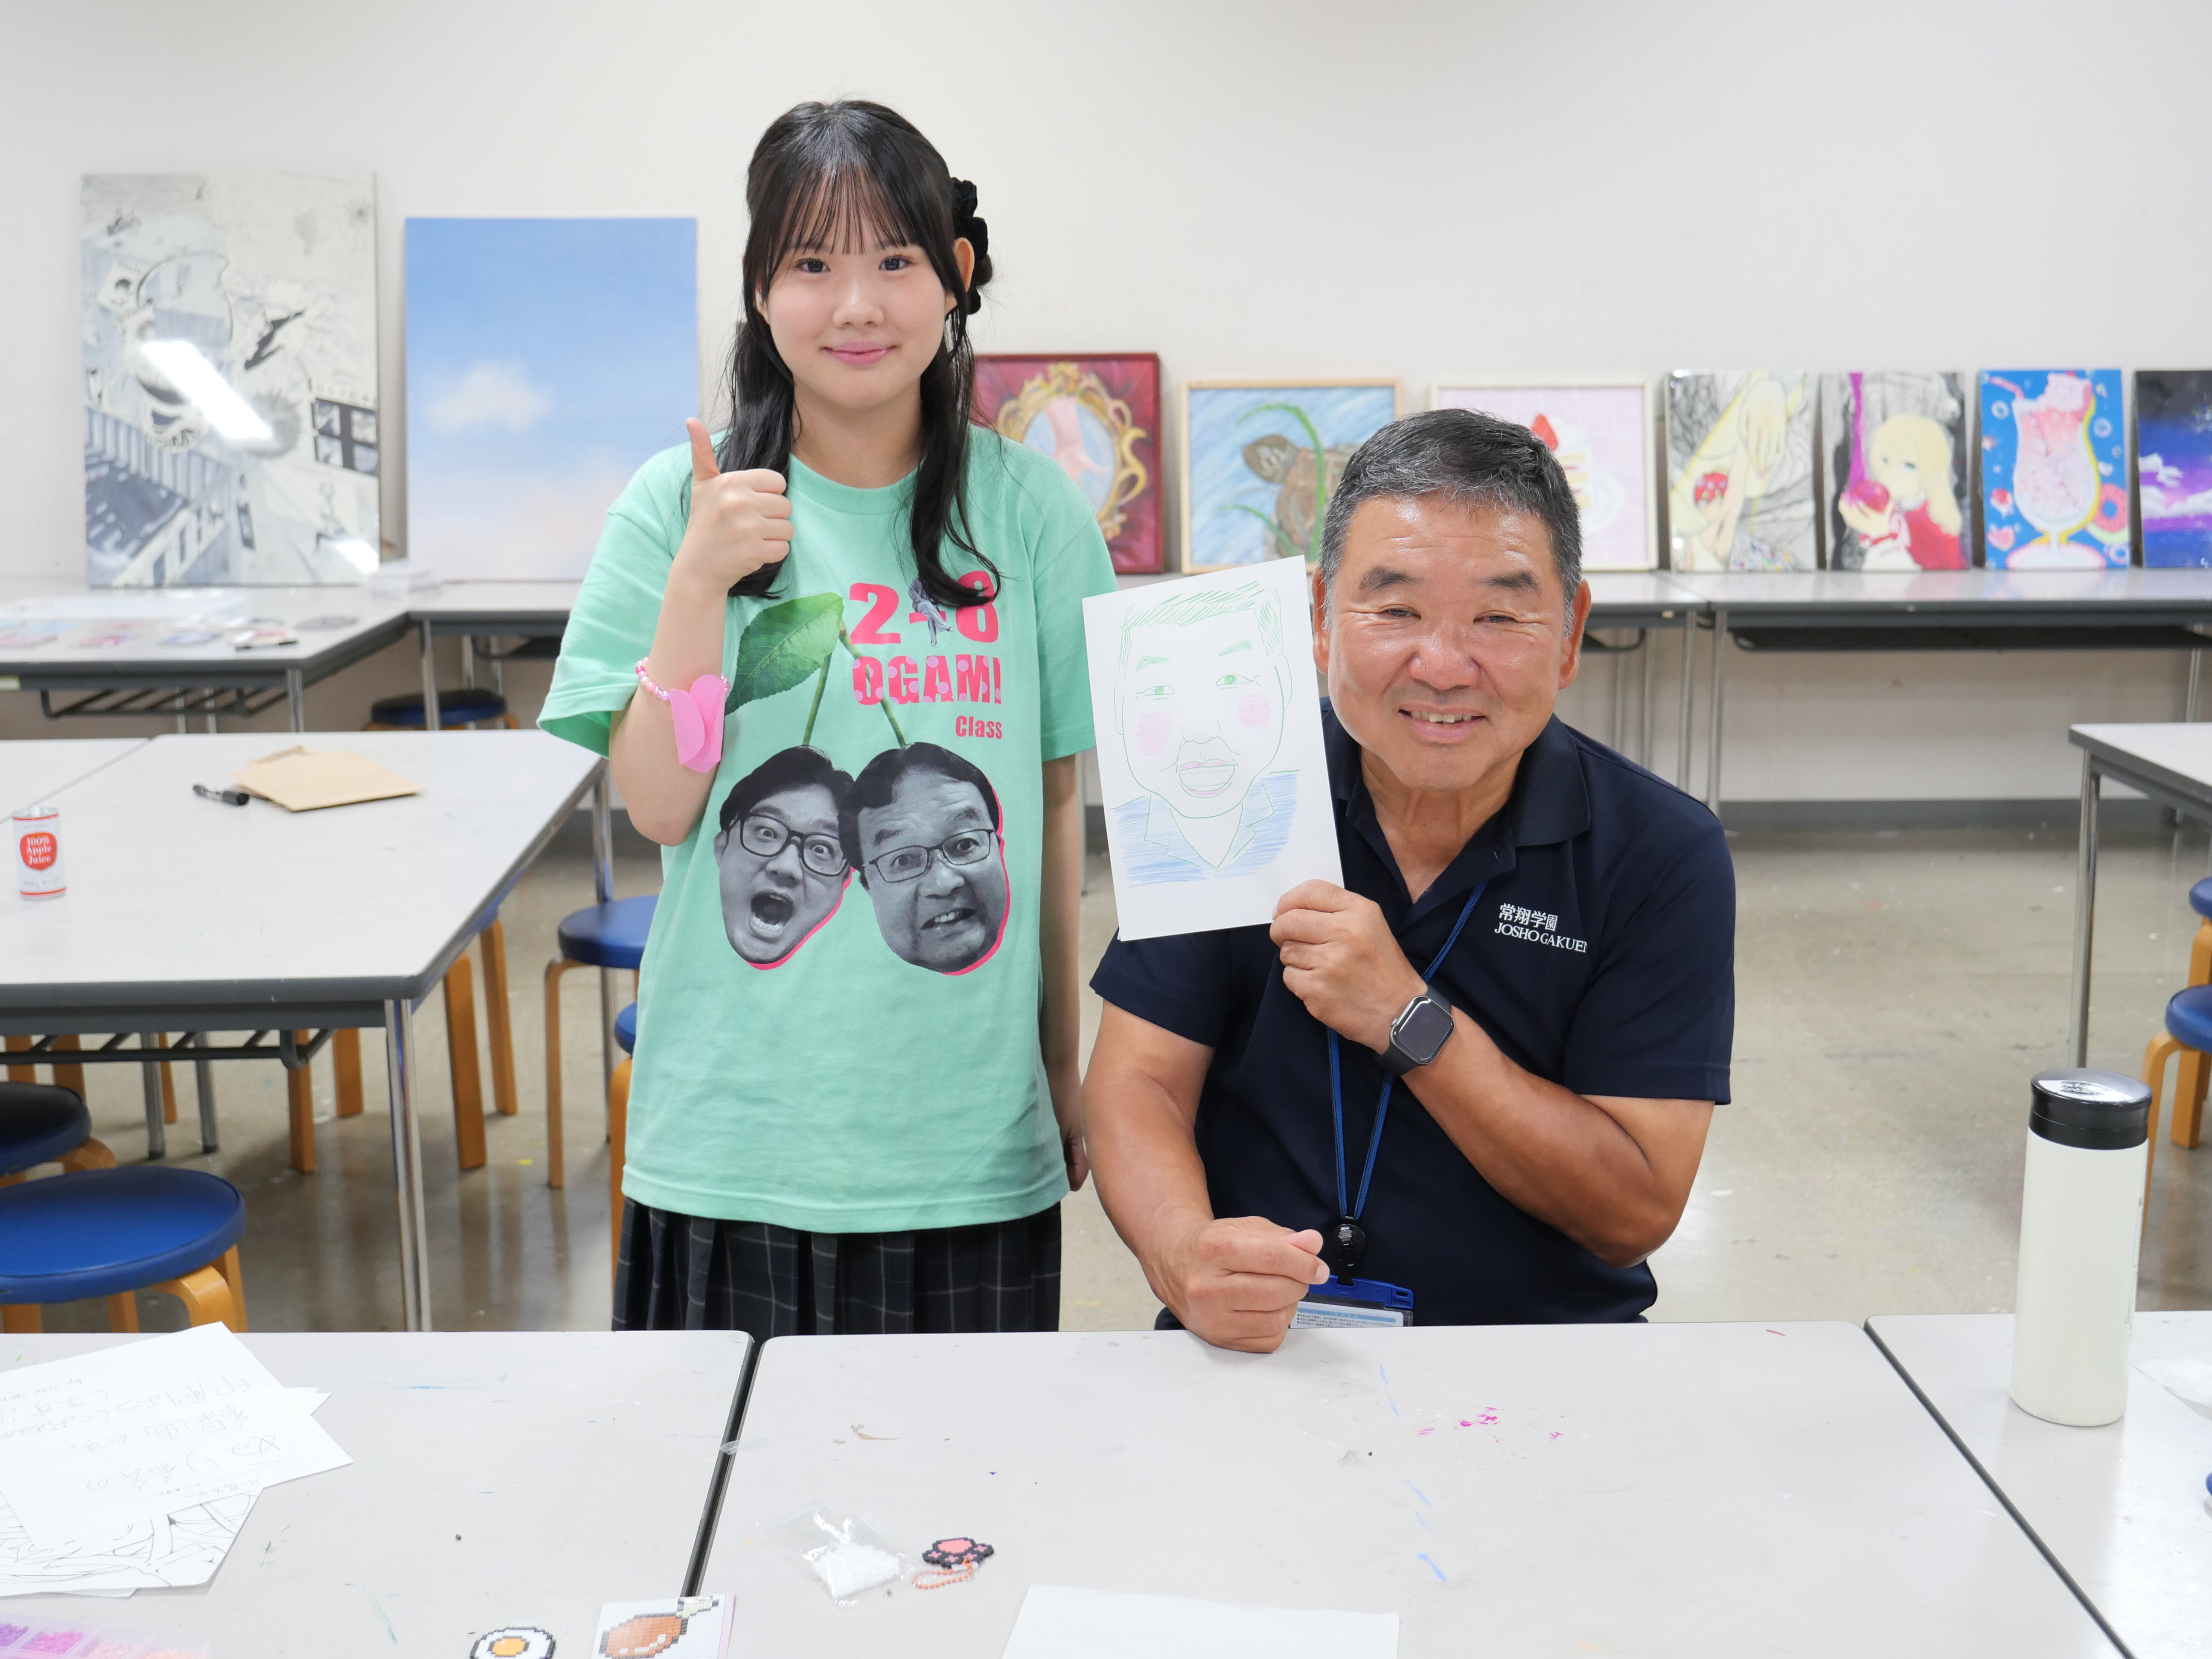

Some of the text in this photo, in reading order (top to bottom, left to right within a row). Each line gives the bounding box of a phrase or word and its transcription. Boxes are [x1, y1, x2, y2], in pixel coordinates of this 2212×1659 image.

[852, 654, 1001, 706] OGAMI
[955, 715, 1003, 739] Class
[26, 844, 52, 856] Apple
[28, 854, 52, 865] Juice
[1499, 902, 1559, 932] 常翔学園
[1494, 922, 1540, 942] JOSHO
